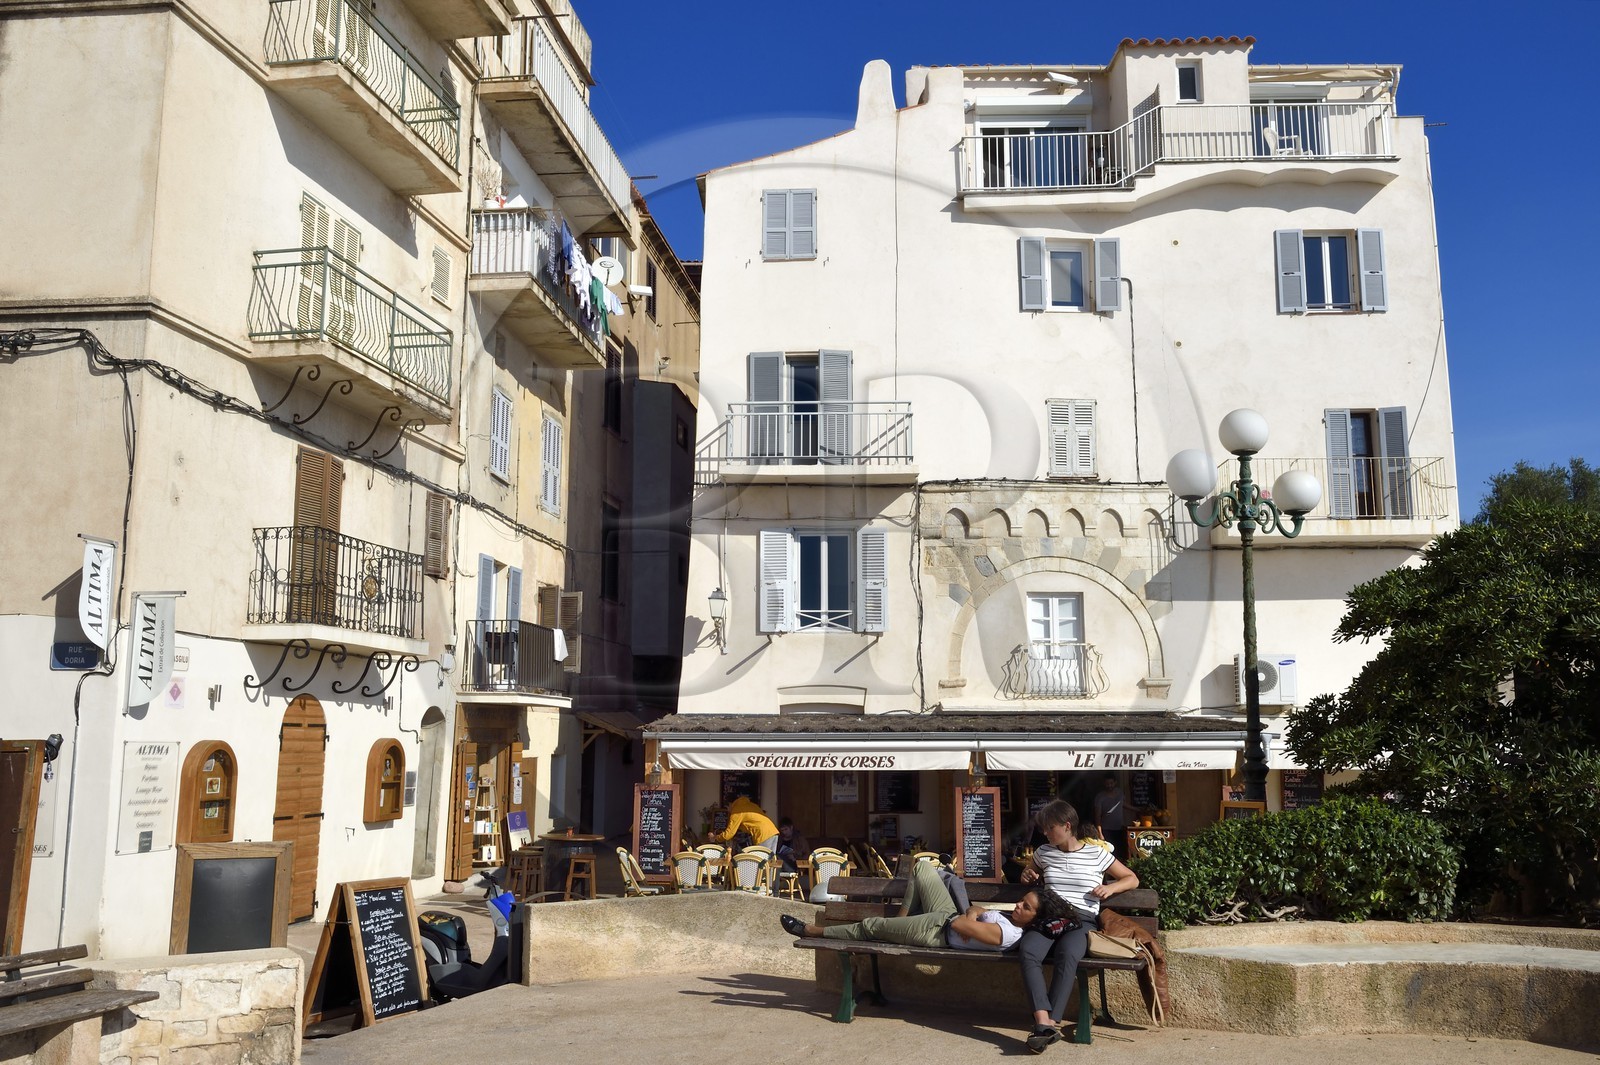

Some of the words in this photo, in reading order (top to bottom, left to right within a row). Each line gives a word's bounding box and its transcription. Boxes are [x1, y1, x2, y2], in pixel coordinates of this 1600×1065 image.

[88, 548, 103, 636] ALTIMA
[68, 646, 83, 654] RUE
[138, 602, 156, 691] ALTIMA
[64, 656, 85, 664] DORIA
[136, 745, 169, 755] ALTIMA
[745, 753, 838, 768] SPÉCIALITÉS
[841, 755, 895, 768] CORSES
[1068, 750, 1096, 768] "LE
[1104, 750, 1154, 768] TIME"
[1140, 838, 1162, 847] Pietra
